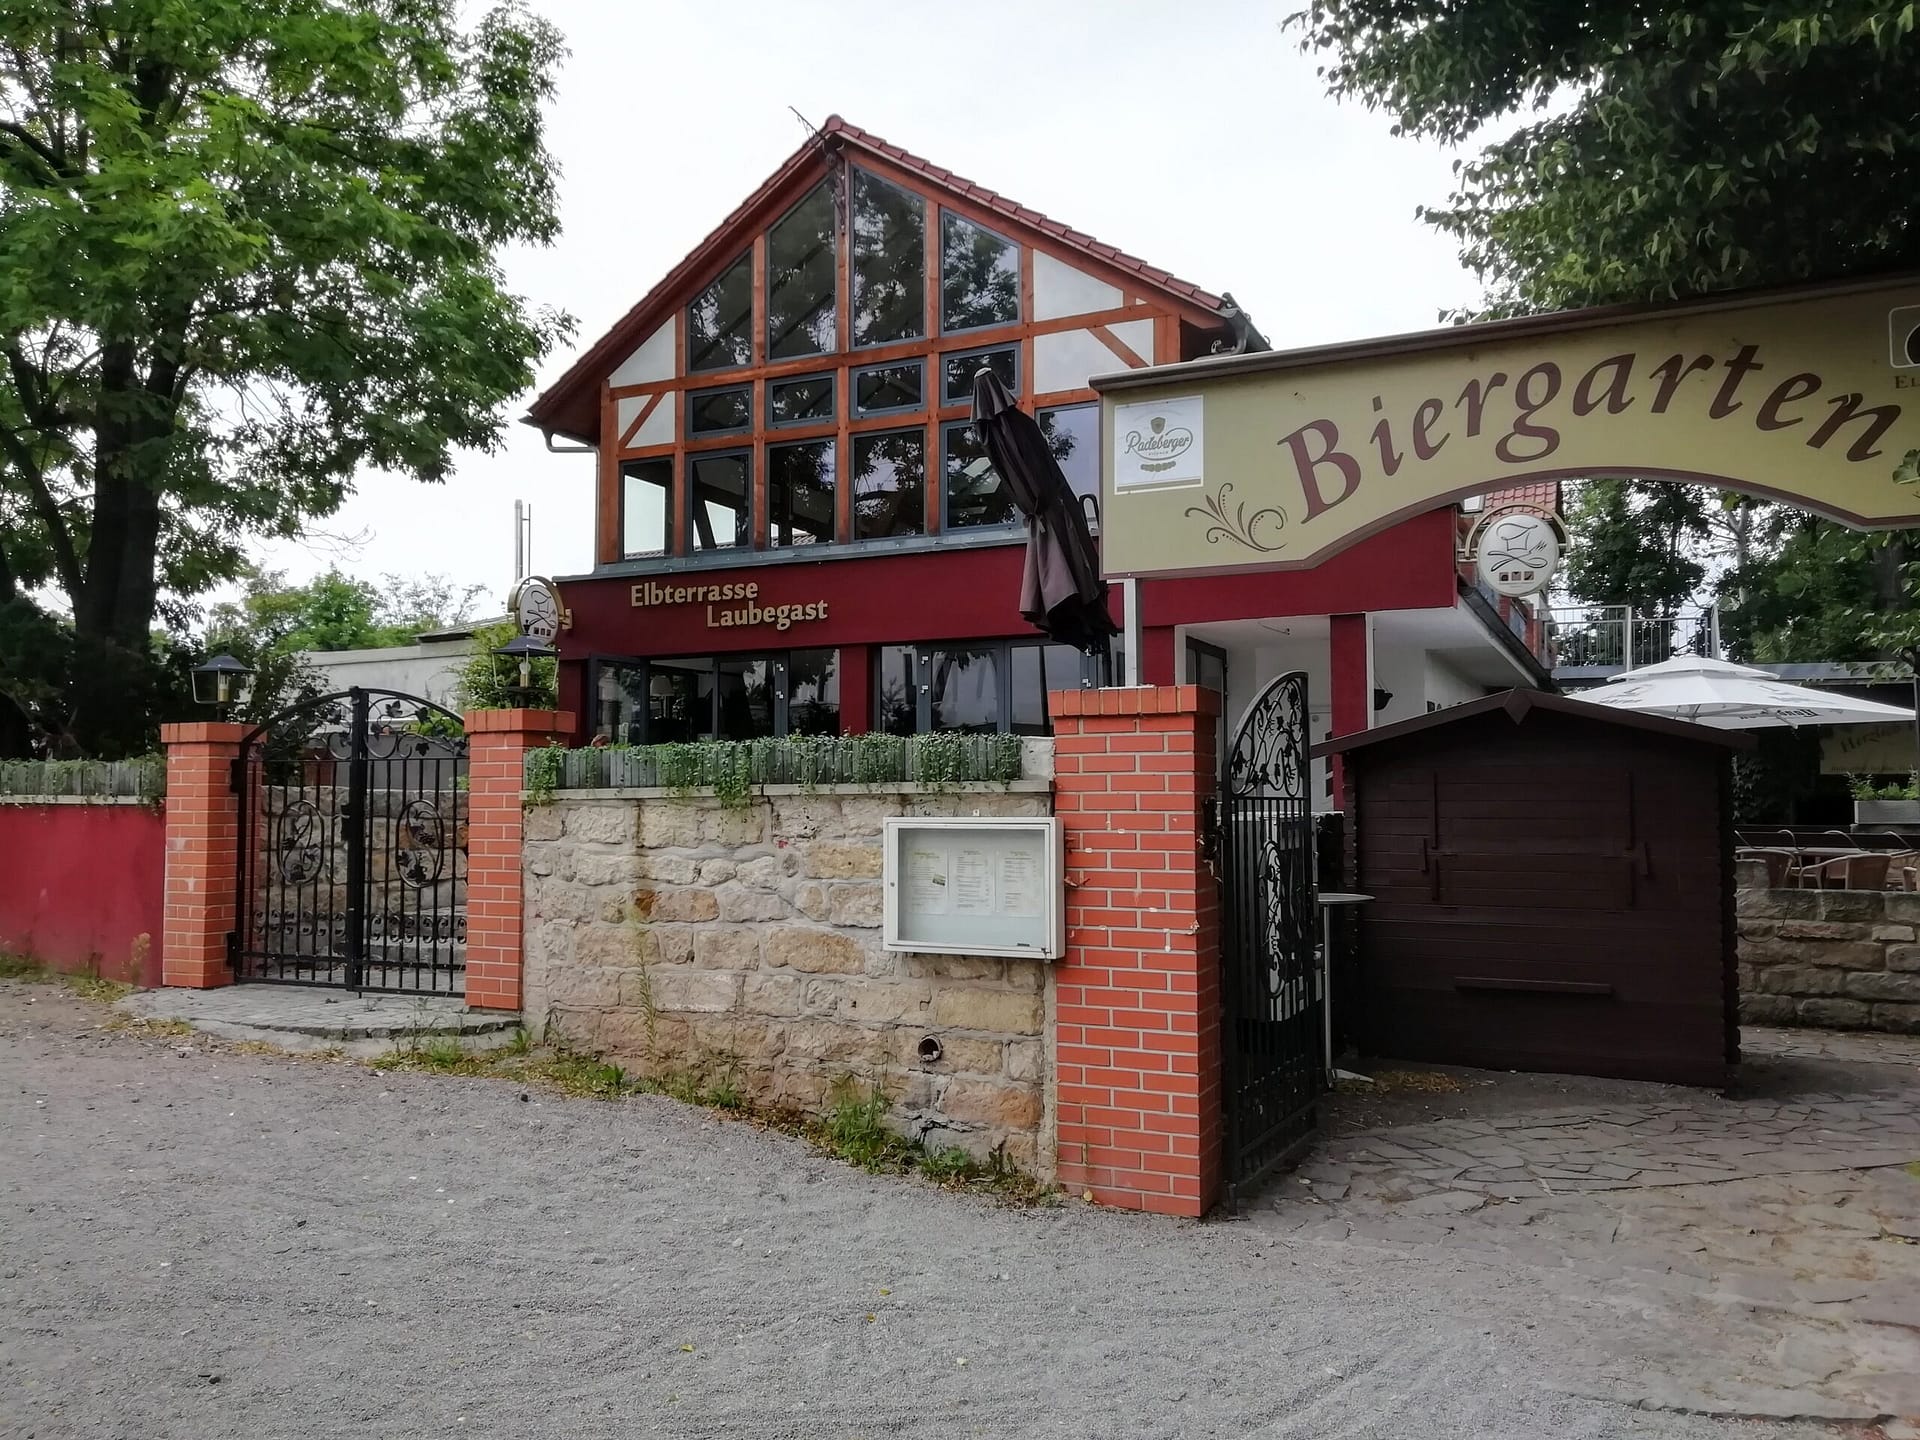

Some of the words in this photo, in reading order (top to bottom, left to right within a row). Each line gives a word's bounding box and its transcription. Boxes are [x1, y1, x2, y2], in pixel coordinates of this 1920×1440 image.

[1125, 430, 1191, 456] Radeberger
[1279, 344, 1902, 523] Biergarten
[631, 582, 759, 606] Elbterrasse
[707, 599, 828, 630] Laubegast
